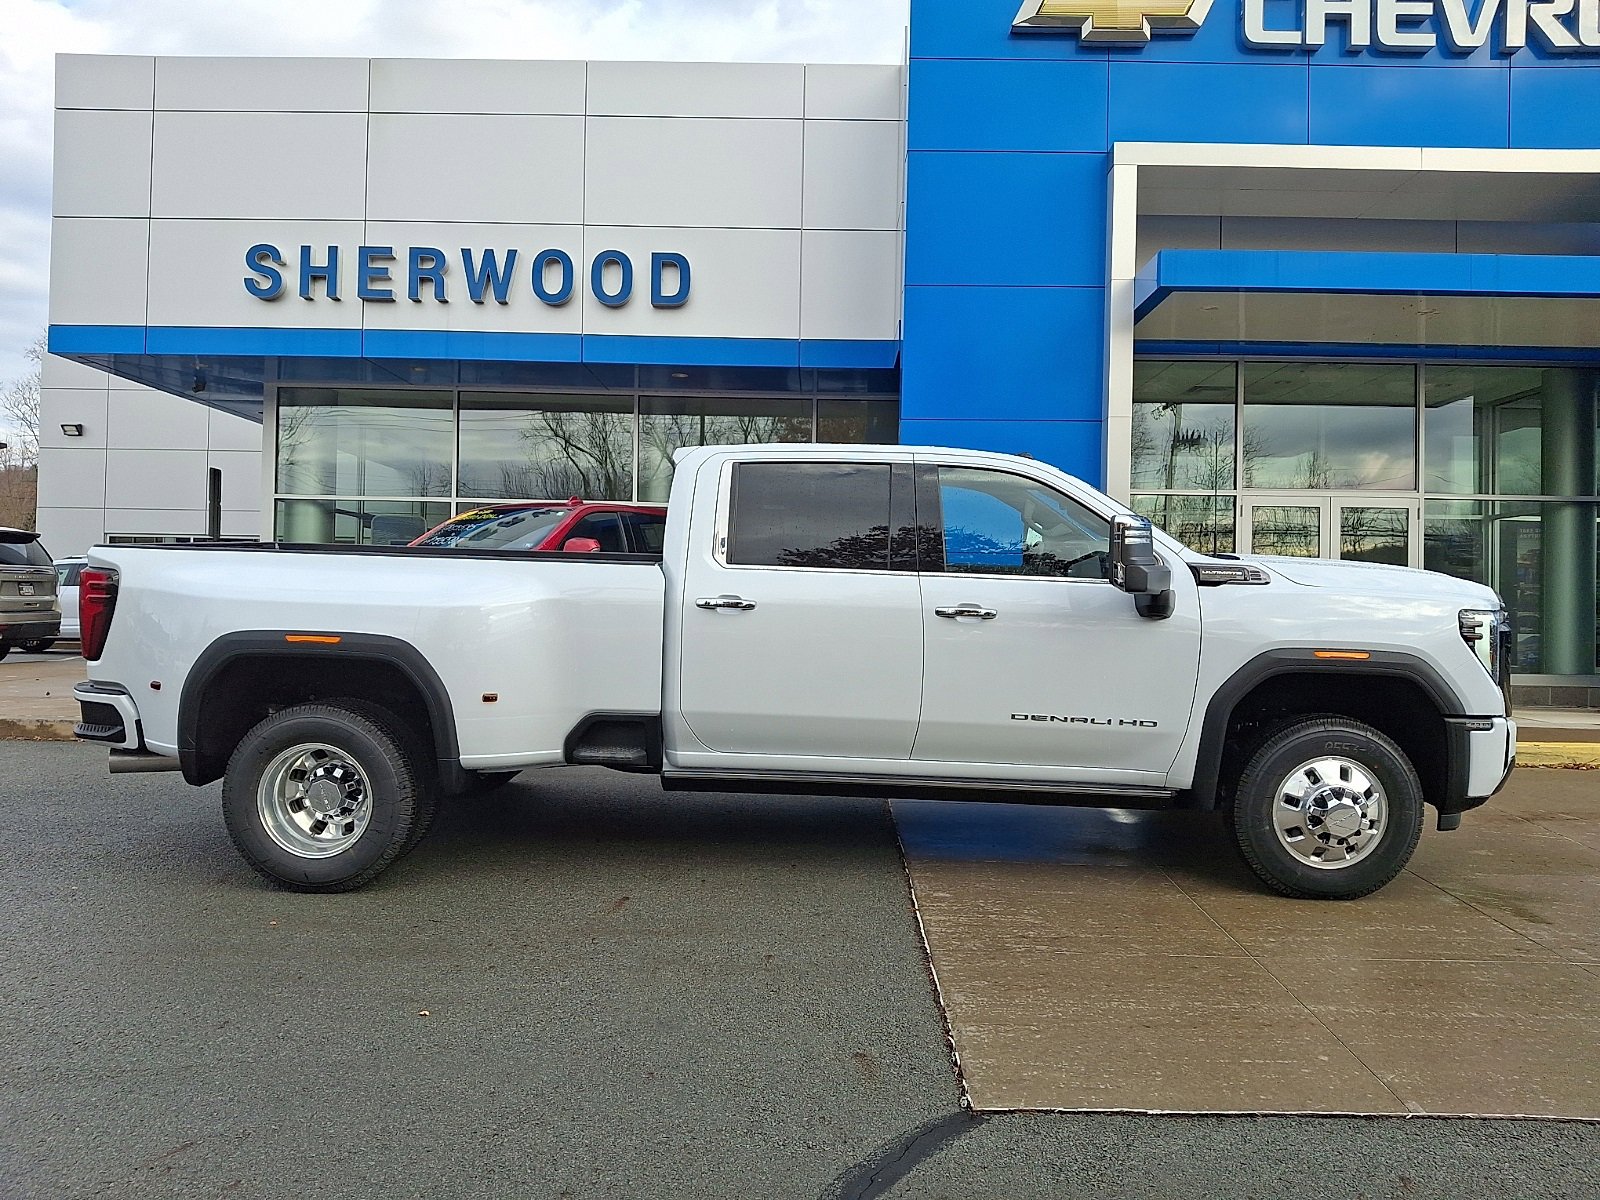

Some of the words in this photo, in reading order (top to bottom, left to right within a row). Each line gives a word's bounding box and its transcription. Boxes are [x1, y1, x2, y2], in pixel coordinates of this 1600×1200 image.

[1242, 0, 1600, 49] CHEVR
[244, 243, 693, 307] SHERWOOD
[1010, 712, 1112, 725] DENALI
[1118, 719, 1159, 728] HD
